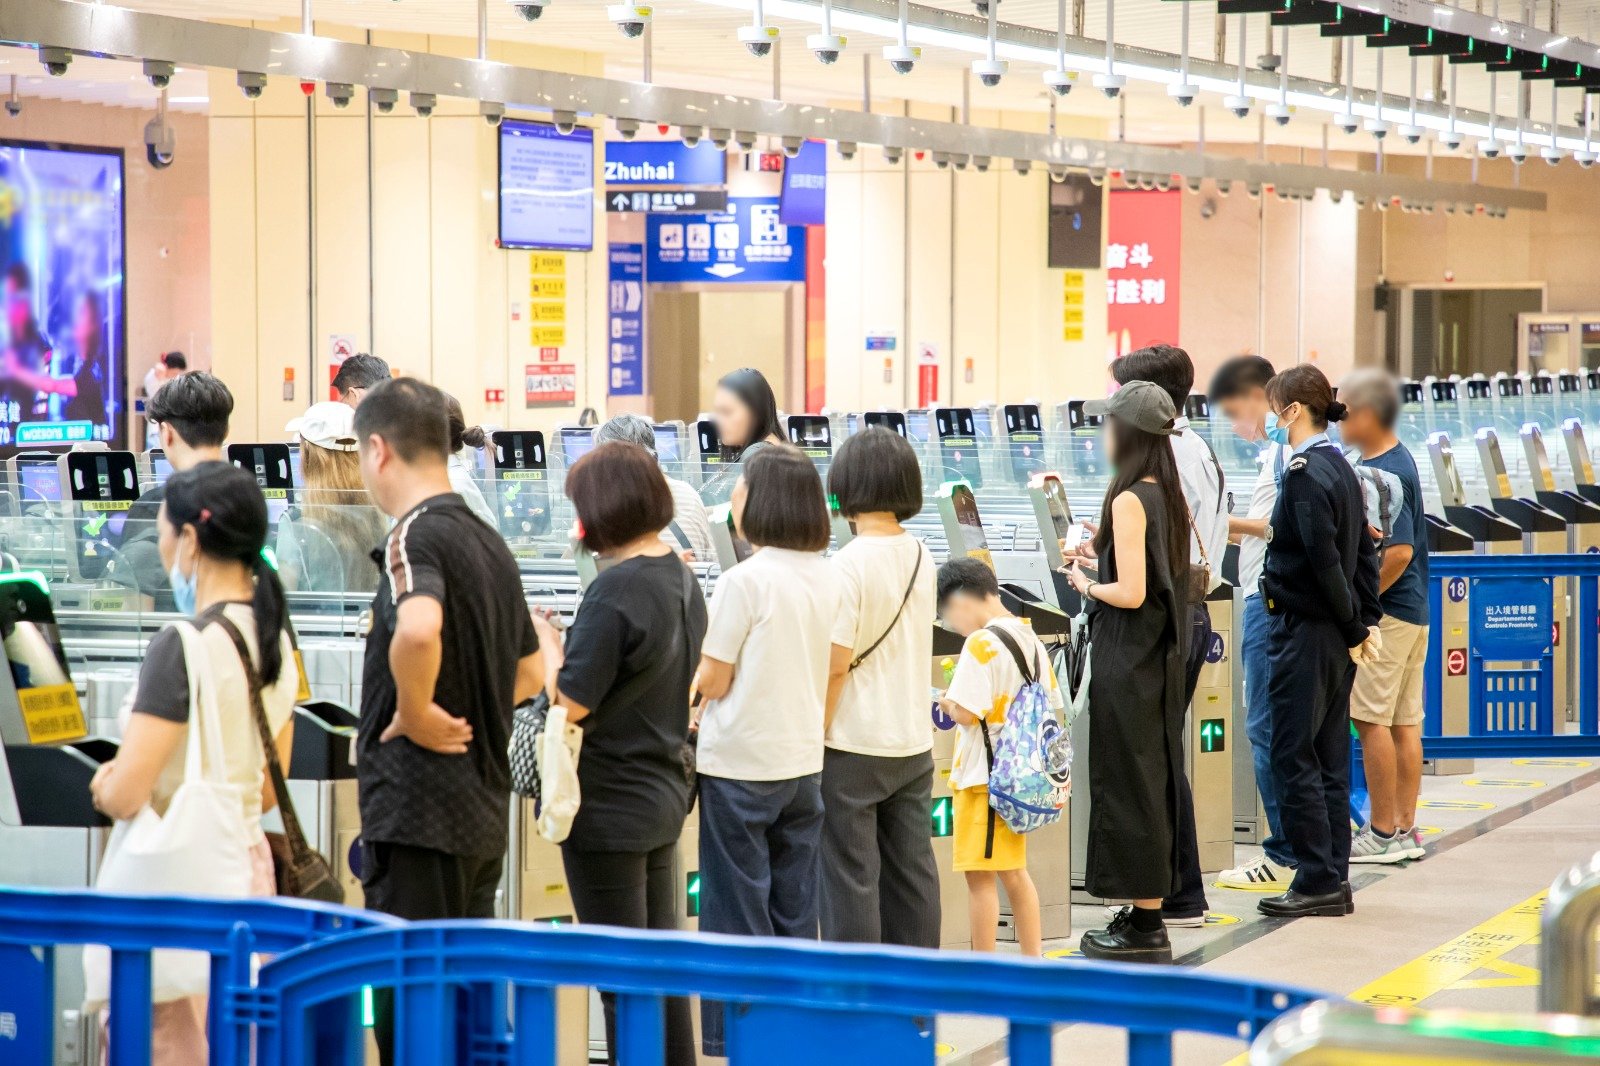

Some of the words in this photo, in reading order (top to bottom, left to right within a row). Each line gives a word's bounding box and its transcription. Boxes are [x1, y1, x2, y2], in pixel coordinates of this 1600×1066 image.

[604, 160, 675, 181] Zhuhai
[1106, 242, 1153, 270] 奋斗
[1449, 581, 1465, 598] 18
[1206, 638, 1222, 657] 4
